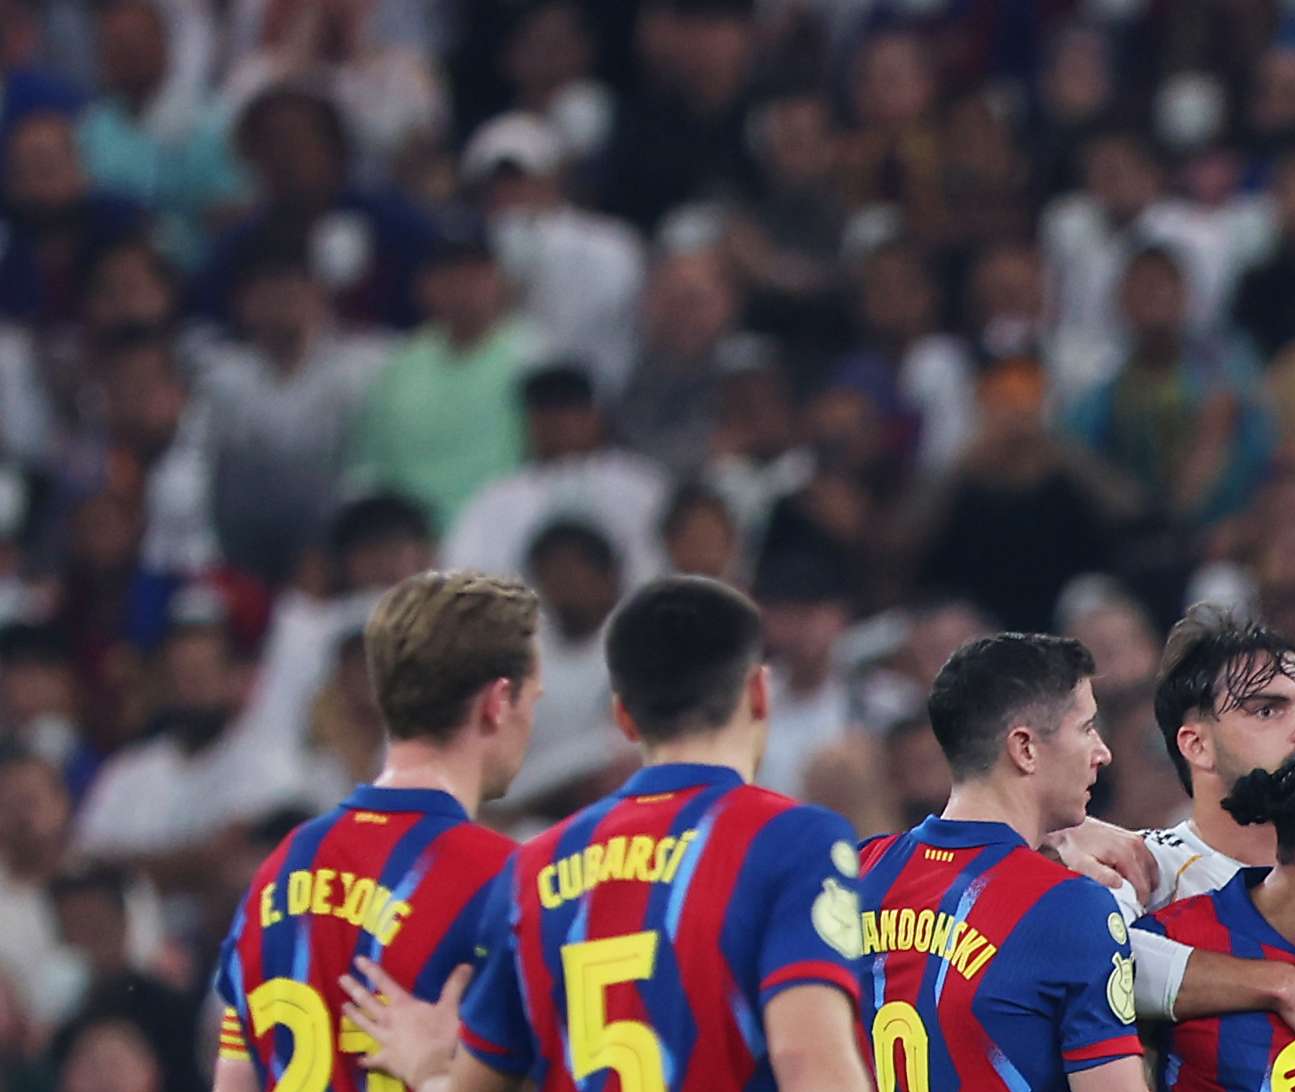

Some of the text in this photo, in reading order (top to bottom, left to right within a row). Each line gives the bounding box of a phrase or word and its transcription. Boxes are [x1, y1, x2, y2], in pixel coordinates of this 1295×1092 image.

[287, 868, 336, 916] DE
[537, 829, 700, 910] CUBARSÍ
[862, 907, 997, 980] ANDOWSKI
